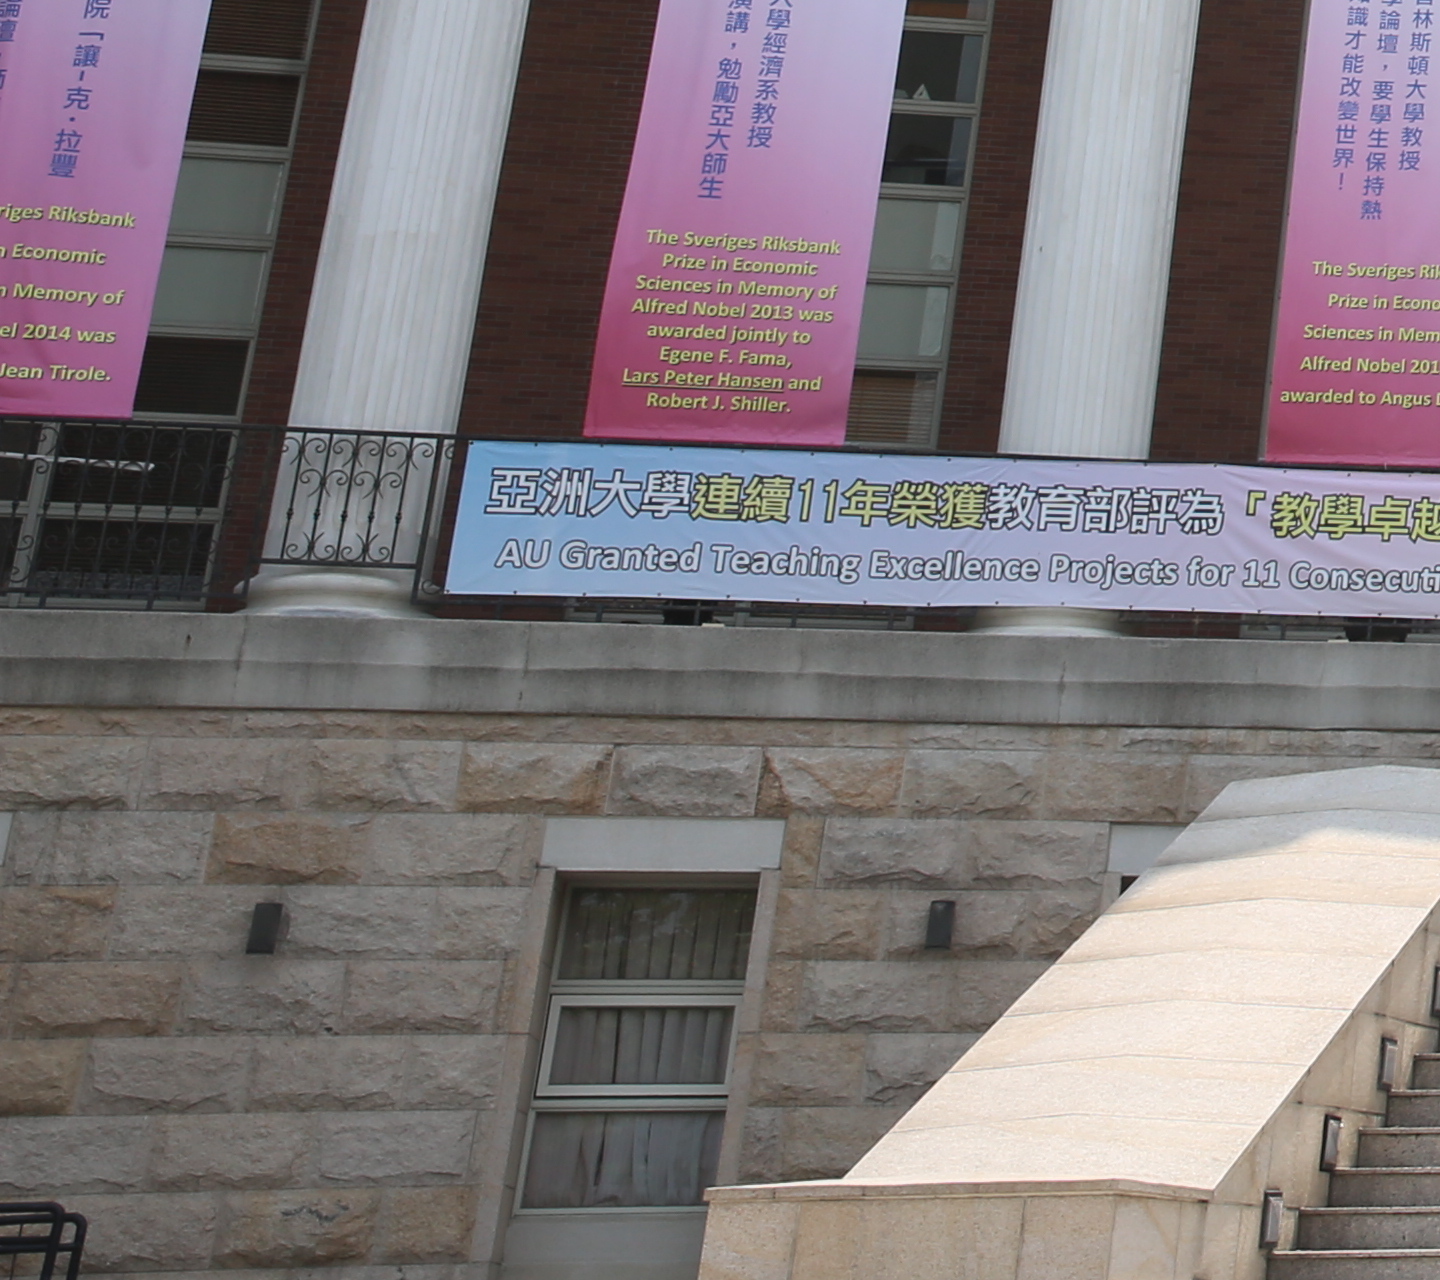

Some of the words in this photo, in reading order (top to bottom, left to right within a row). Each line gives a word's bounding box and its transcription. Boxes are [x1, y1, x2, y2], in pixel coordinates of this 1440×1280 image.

[48, 205, 136, 228] Riksbank
[12, 243, 107, 265] Economic
[13, 283, 98, 306] Memory
[102, 290, 125, 305] of
[631, 298, 687, 316] Alfred
[693, 302, 746, 318] Nobel
[750, 305, 793, 320] 2013
[799, 310, 833, 322] was
[23, 324, 71, 341] 2014
[77, 330, 116, 343] was
[647, 325, 726, 340] awarded
[731, 326, 788, 344] jointly
[792, 330, 810, 344] to
[660, 347, 713, 364] Egene
[719, 350, 732, 364] F.
[739, 351, 792, 368] Fama,
[1300, 357, 1351, 371] Alfred
[1356, 358, 1405, 373] Nobel
[50, 365, 111, 381] Tirole.
[622, 369, 658, 384] Lars
[665, 370, 712, 386] Peter
[718, 372, 782, 388] Hansen
[788, 377, 822, 390] and
[646, 394, 708, 409] Robert
[712, 397, 724, 410] J.
[730, 396, 792, 412] Shiller.
[1280, 389, 1354, 403] awarded
[1358, 391, 1376, 404] to
[1381, 392, 1431, 408] Angus
[496, 538, 552, 569] AU
[559, 539, 701, 573] Granted
[712, 544, 861, 584] Teaching
[868, 549, 1039, 583] Excellence
[1049, 554, 1179, 589] Projects
[1187, 556, 1235, 587] for
[1242, 560, 1280, 589] 11
